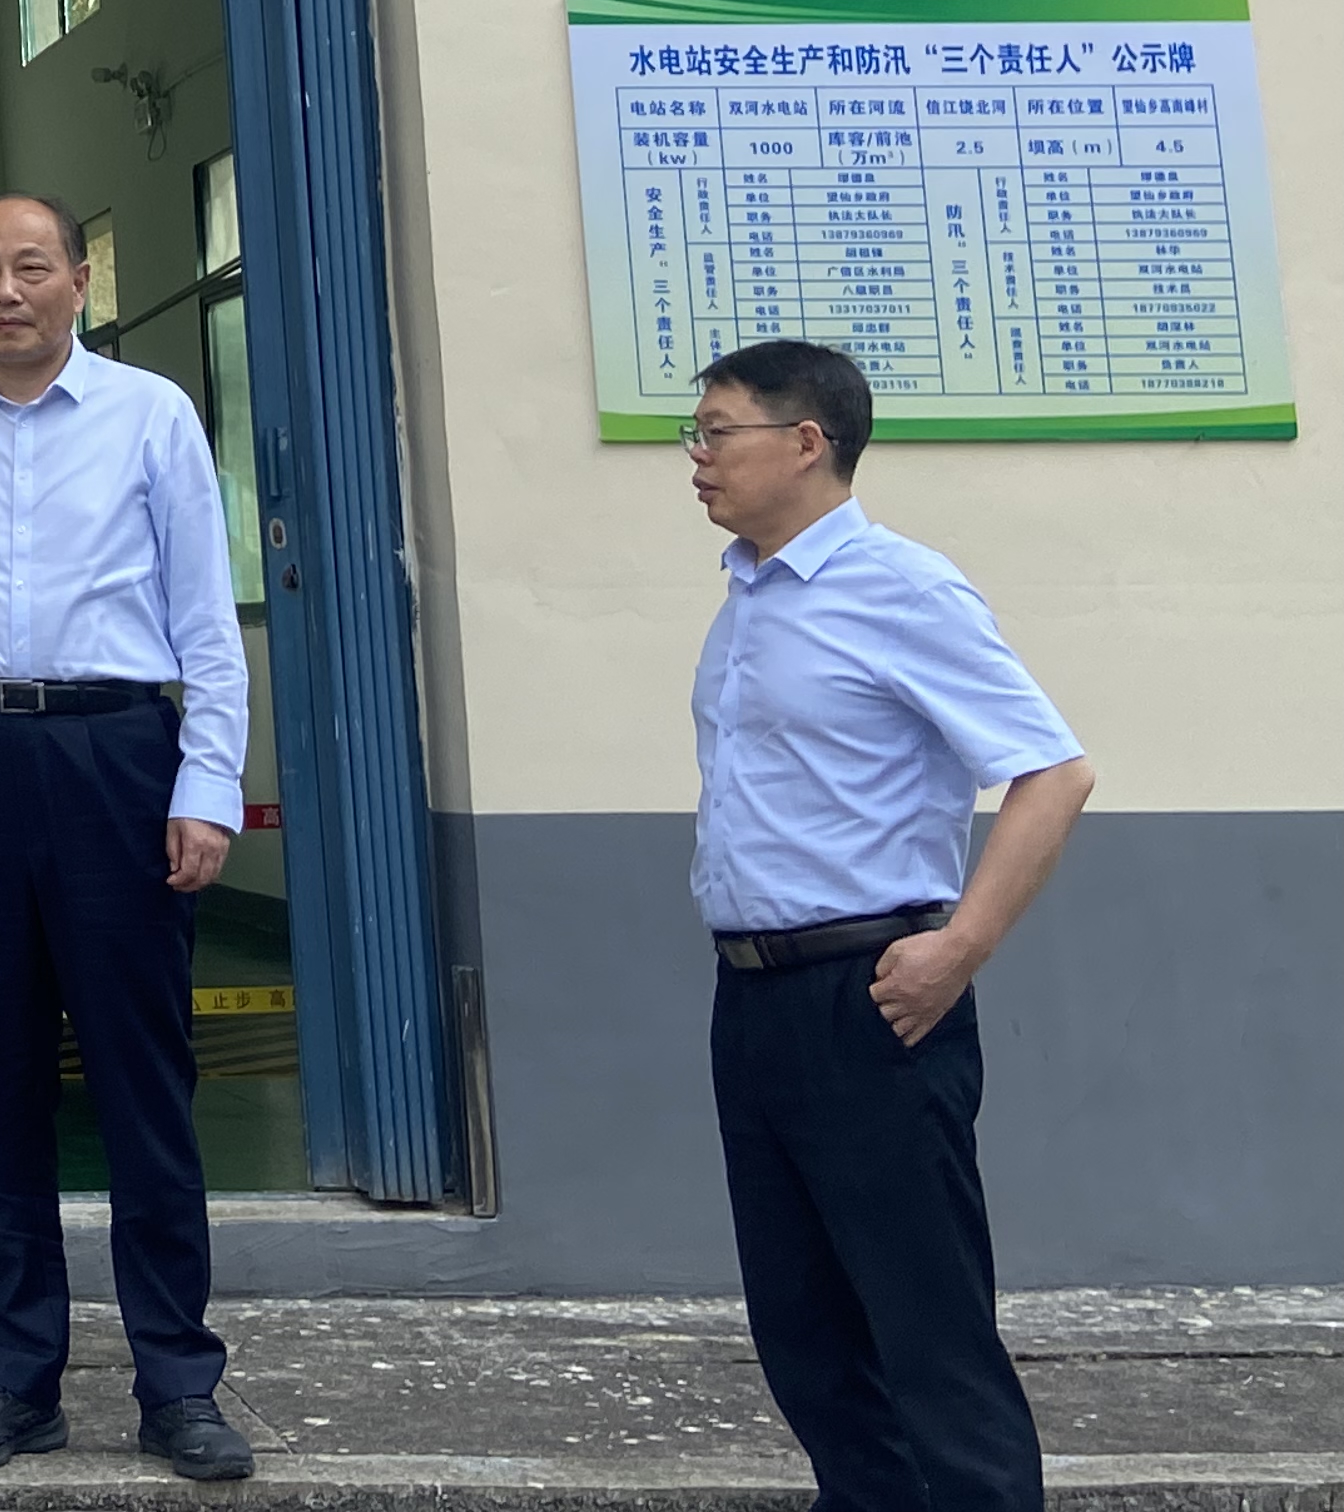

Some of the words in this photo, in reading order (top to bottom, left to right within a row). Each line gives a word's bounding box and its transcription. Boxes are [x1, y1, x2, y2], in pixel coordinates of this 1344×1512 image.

[629, 42, 1196, 76] 水电站安全生产和防汛“三个责任人”公示牌
[630, 100, 707, 116] 电站名称
[729, 100, 808, 115] 双河水电站
[829, 100, 906, 116] 所在河流
[1027, 98, 1104, 115] 所在位置
[633, 131, 710, 147] 装机容量
[828, 130, 912, 147] 库容/前池
[749, 142, 793, 155] 1000
[956, 141, 984, 154] 2.5
[1156, 140, 1184, 154] 4.5
[743, 173, 768, 183] 姓名
[1044, 172, 1068, 182] 姓名
[746, 192, 769, 202] 单位
[1046, 191, 1070, 201] 单位
[747, 212, 771, 223] 职务
[749, 231, 773, 242] 电话
[750, 247, 774, 257] 姓名
[752, 267, 777, 277] 单位
[214, 991, 250, 1009] 止步
